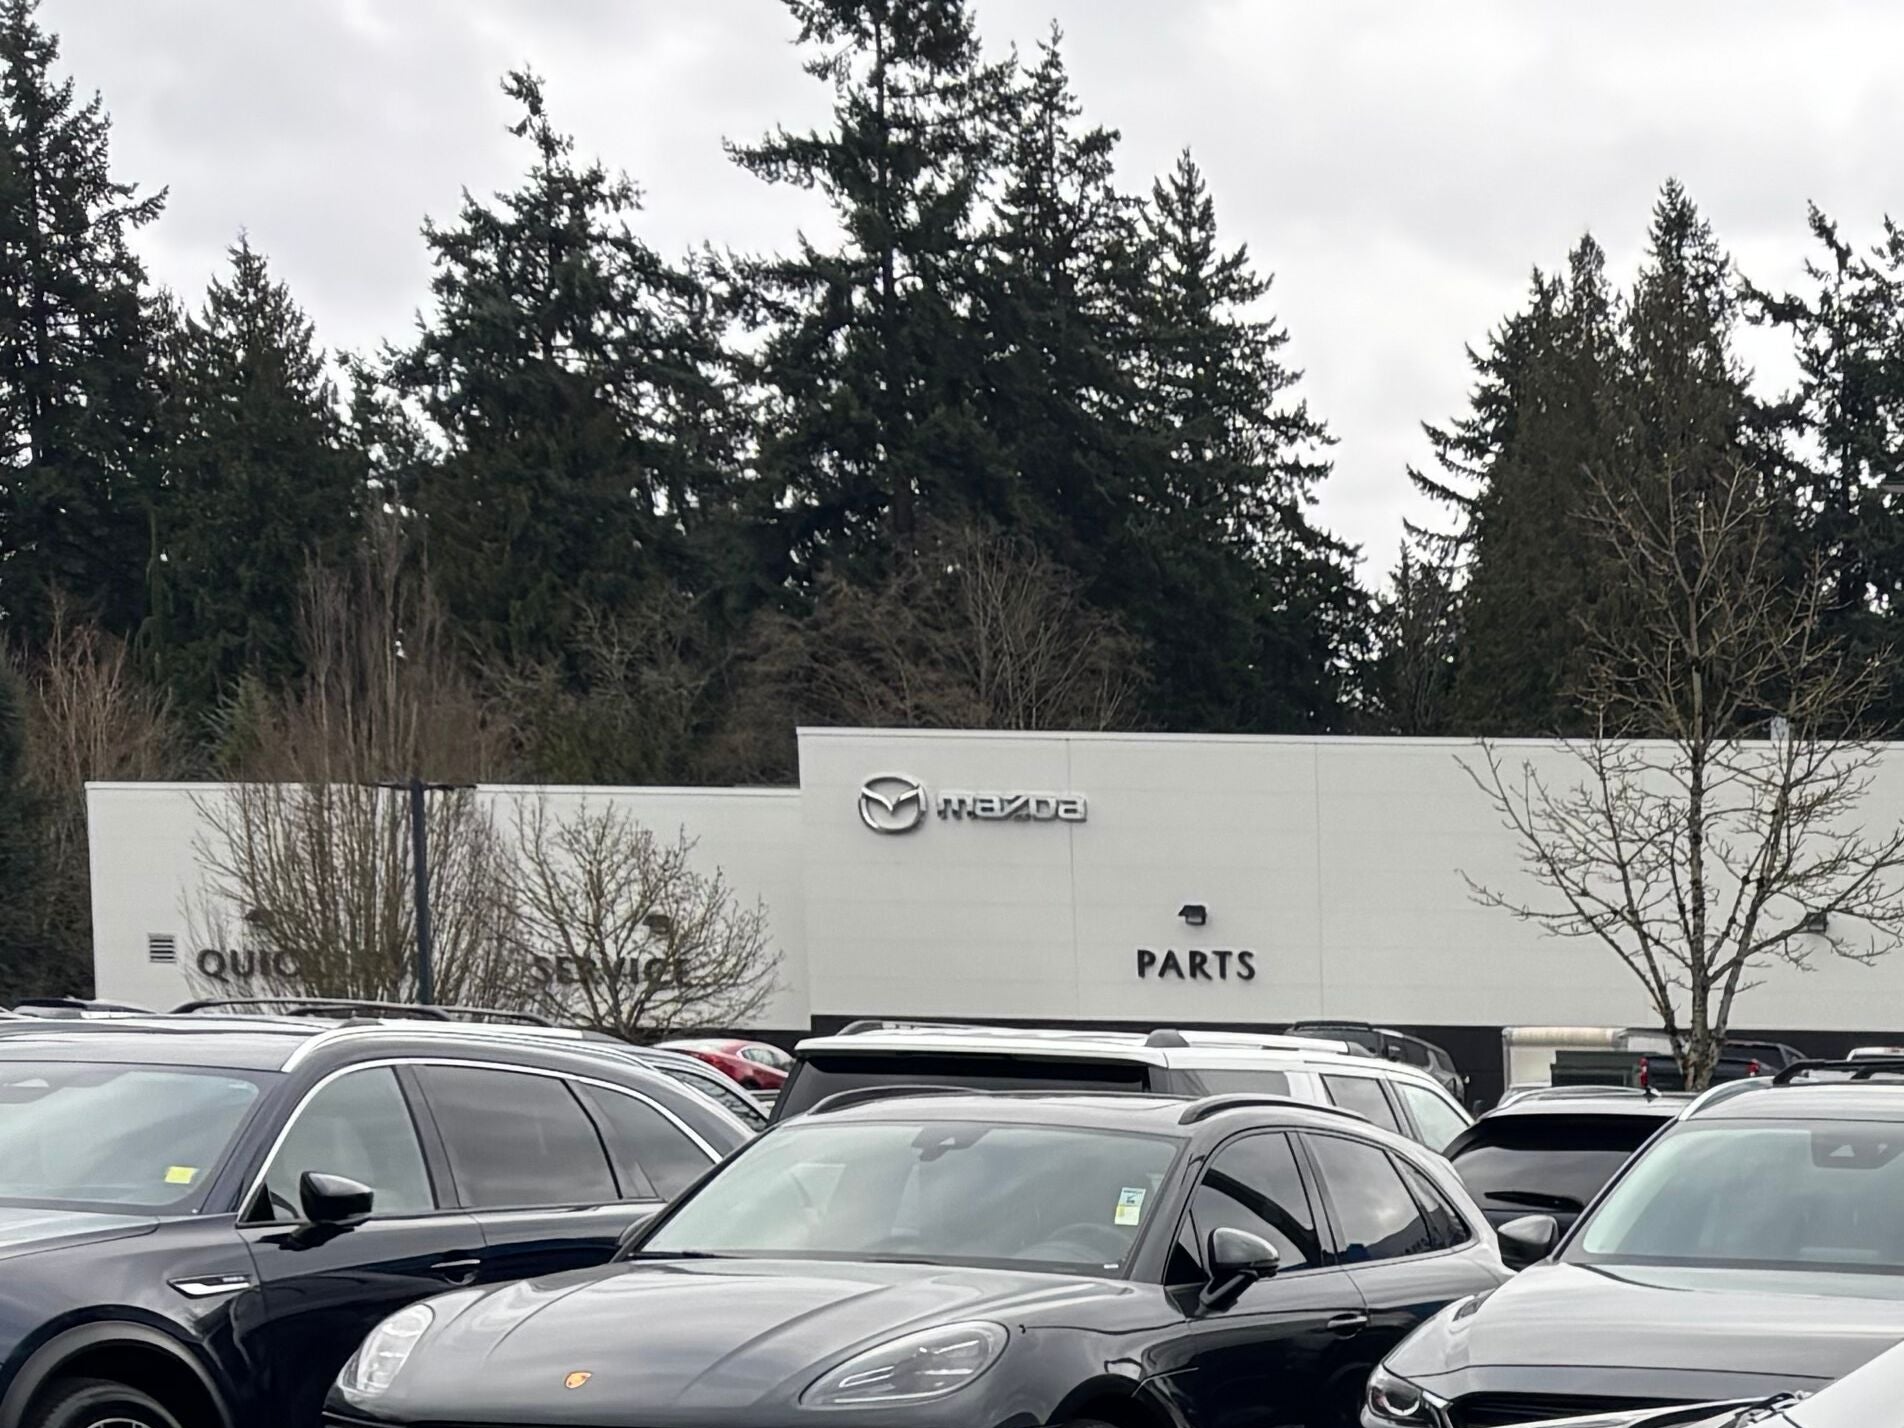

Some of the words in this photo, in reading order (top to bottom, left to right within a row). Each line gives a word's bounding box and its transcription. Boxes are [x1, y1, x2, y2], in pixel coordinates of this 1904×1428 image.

[937, 791, 1088, 822] mazda
[196, 948, 324, 983] QUIC
[1137, 949, 1256, 981] PARTS
